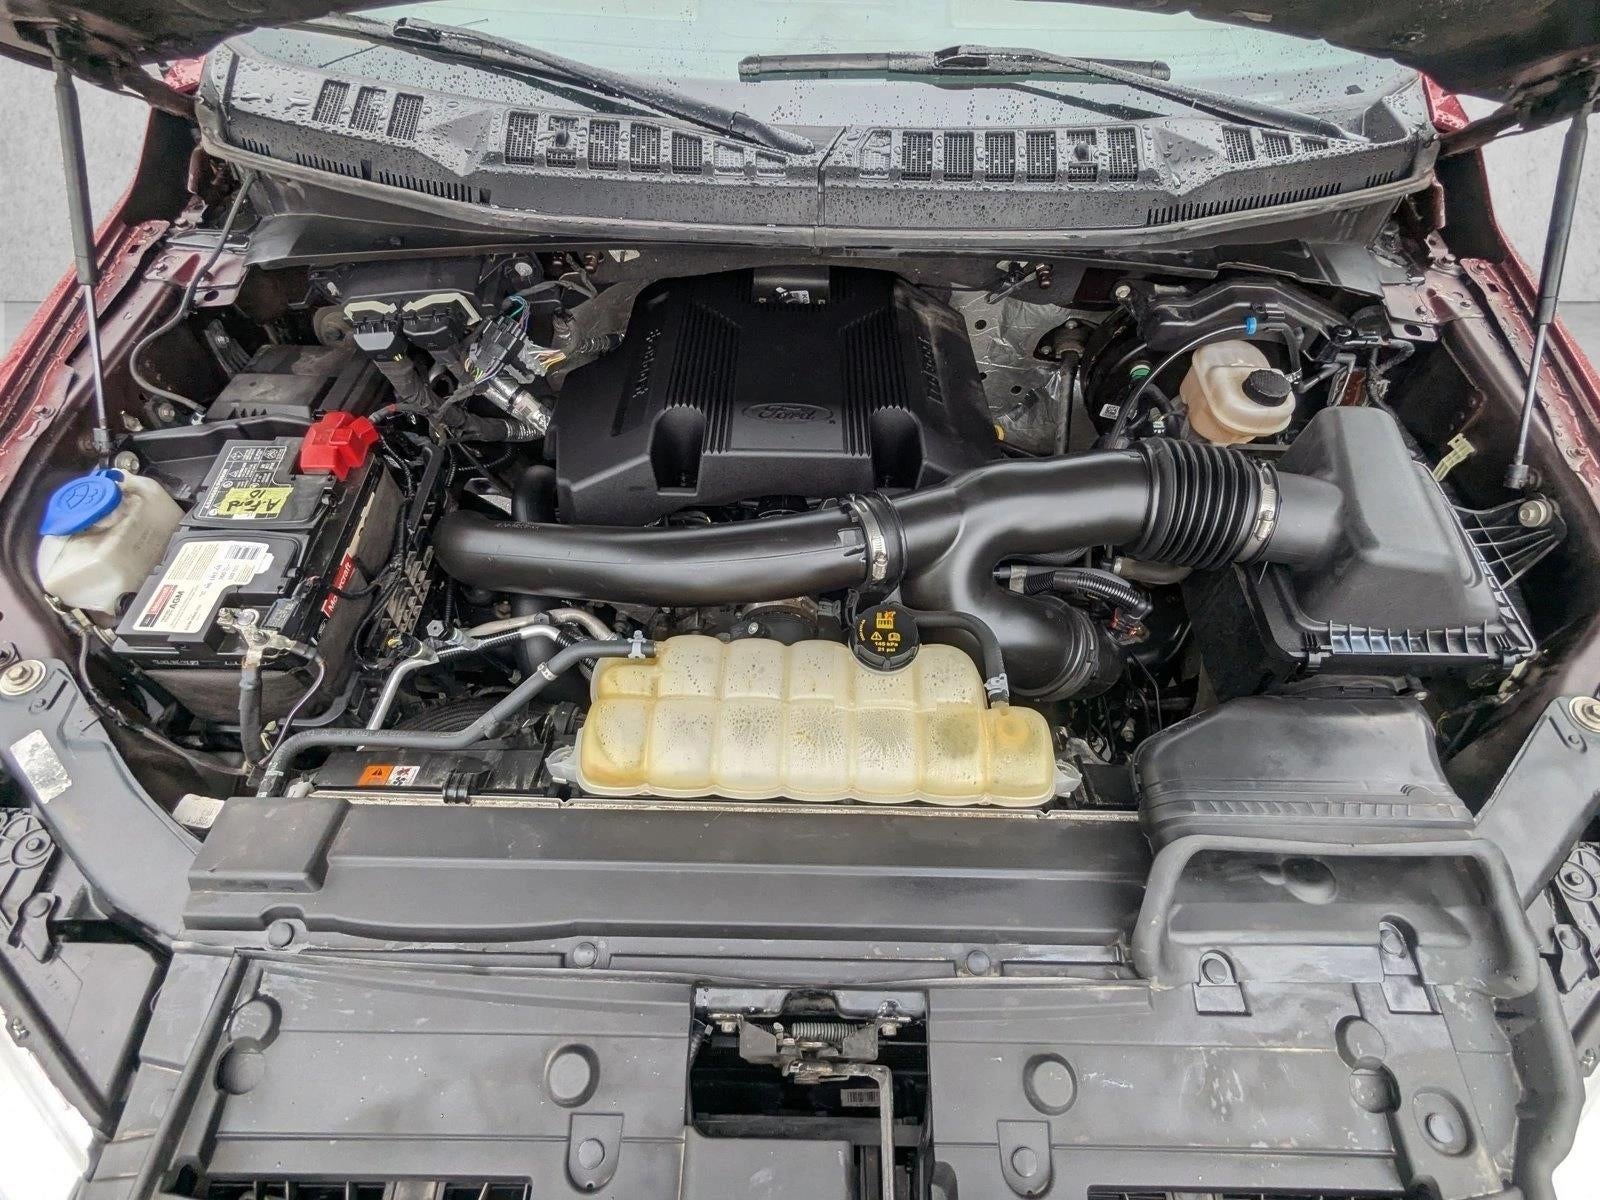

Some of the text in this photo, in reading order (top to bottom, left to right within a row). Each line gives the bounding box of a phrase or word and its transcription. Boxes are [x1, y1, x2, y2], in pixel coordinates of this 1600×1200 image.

[758, 404, 817, 420] Ford
[327, 561, 352, 612] Morcraft
[171, 590, 185, 610] AGM
